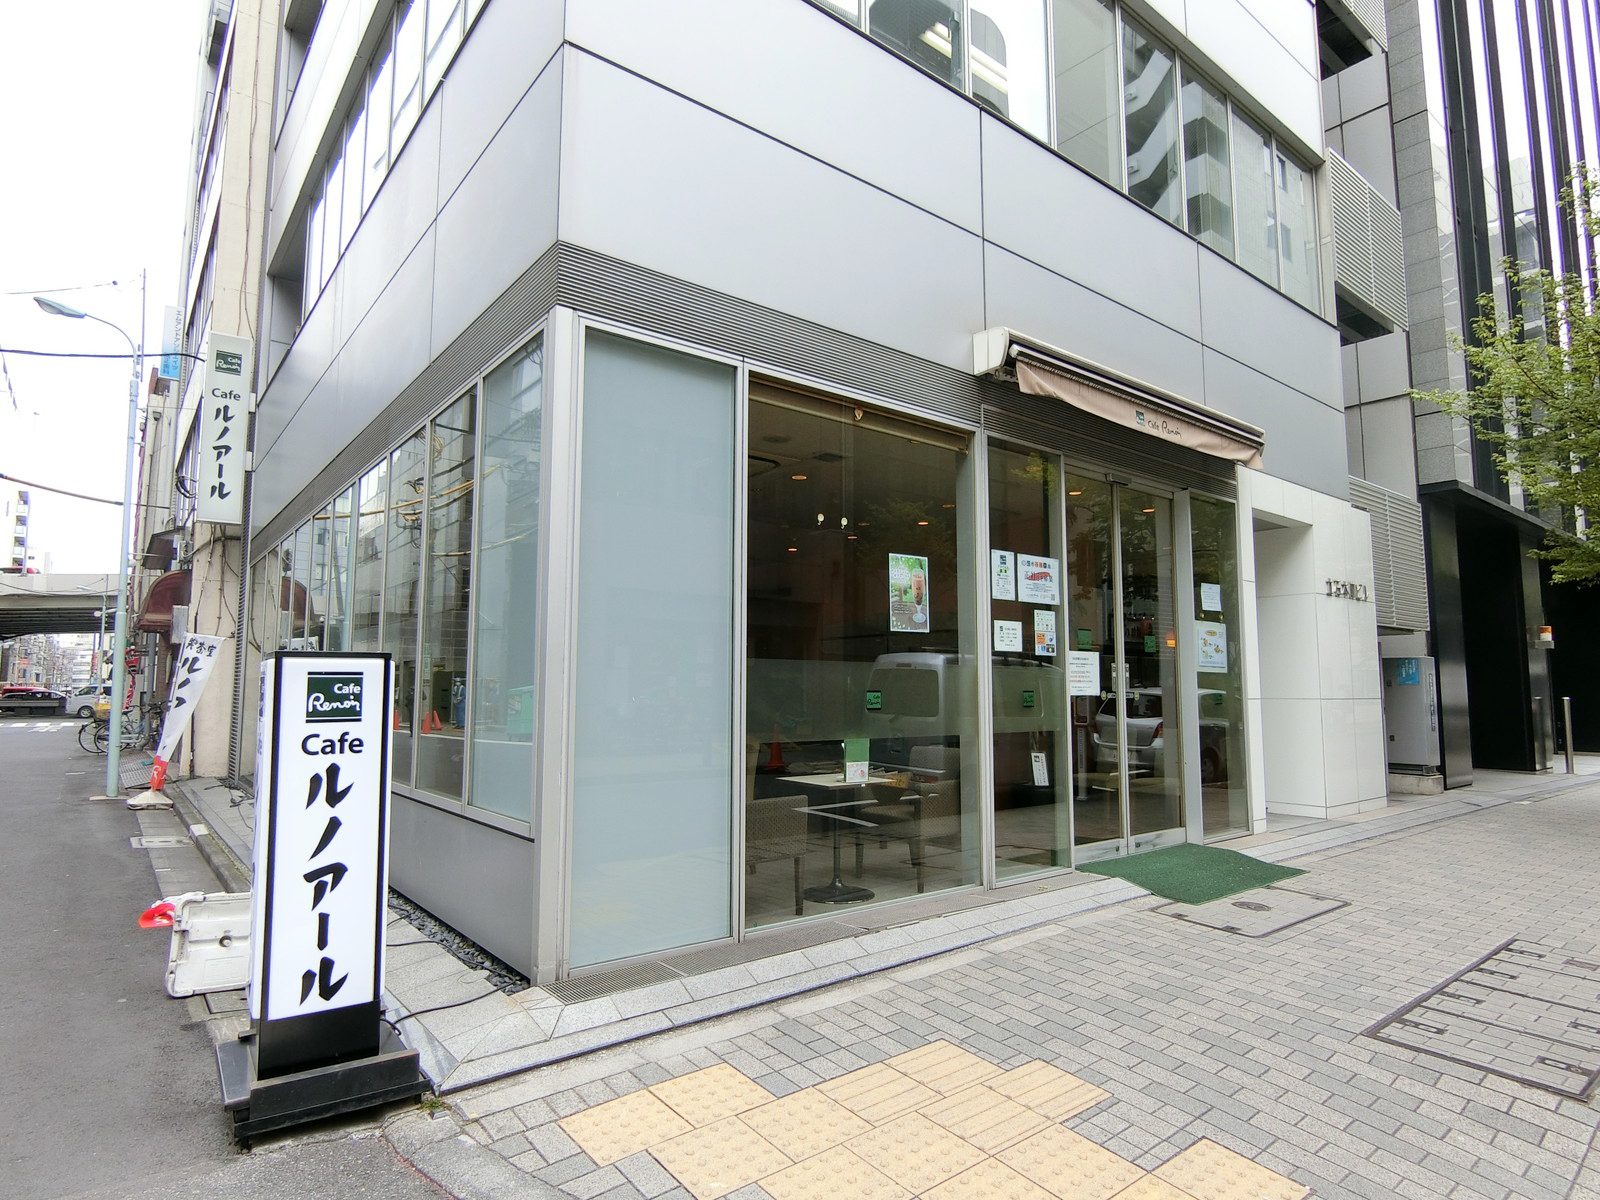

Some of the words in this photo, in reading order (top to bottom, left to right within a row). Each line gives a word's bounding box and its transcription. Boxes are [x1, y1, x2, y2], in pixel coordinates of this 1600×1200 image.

[211, 387, 241, 401] Cafe
[209, 404, 236, 500] ルノアール
[334, 683, 361, 694] Cafe
[308, 692, 361, 712] Renoir
[301, 731, 364, 756] Cafe
[299, 762, 354, 1006] ルノアール
